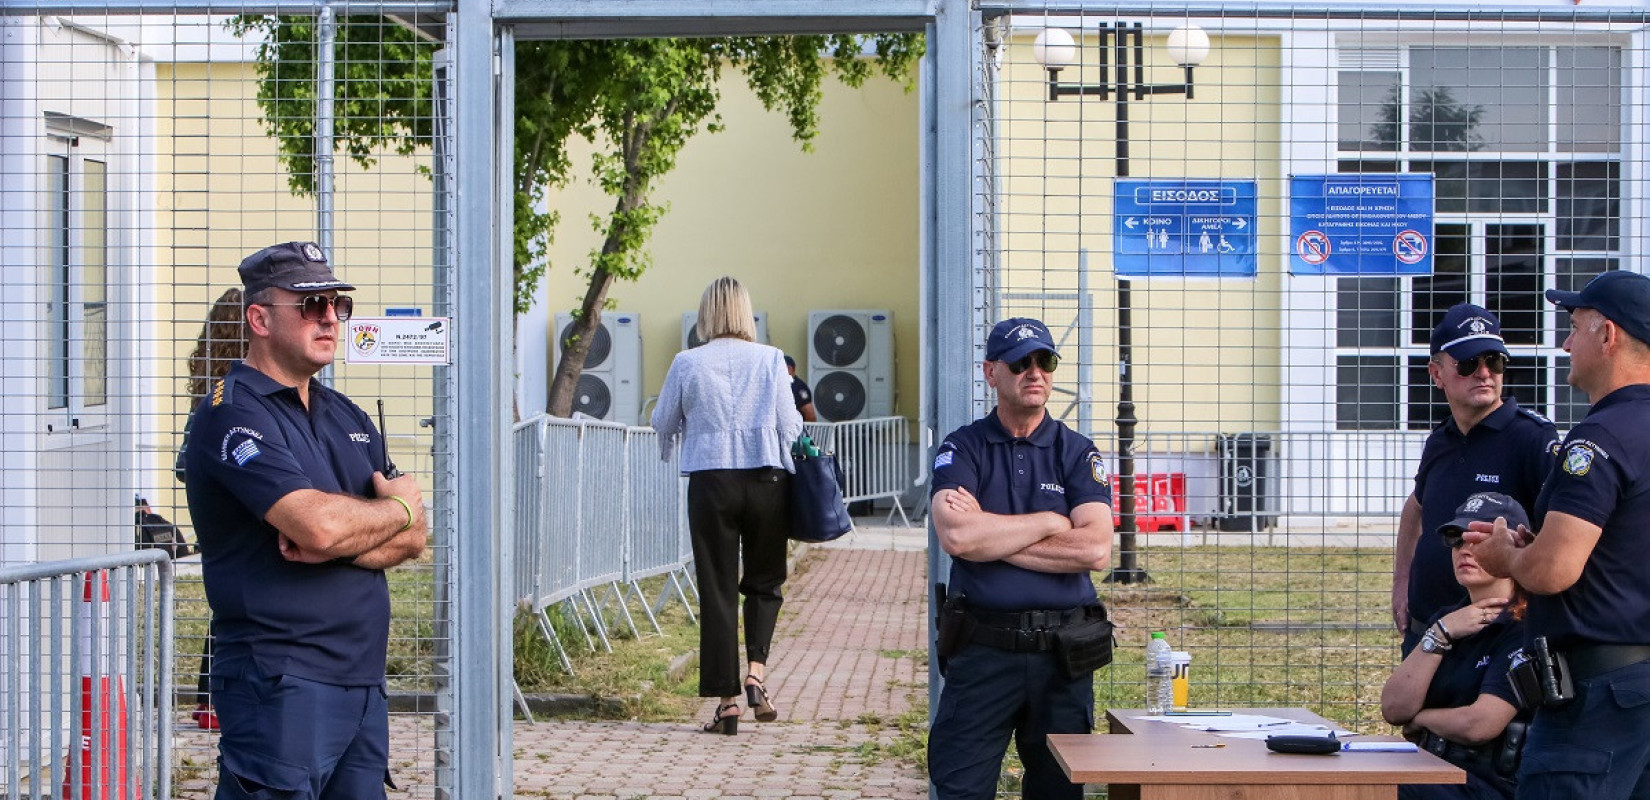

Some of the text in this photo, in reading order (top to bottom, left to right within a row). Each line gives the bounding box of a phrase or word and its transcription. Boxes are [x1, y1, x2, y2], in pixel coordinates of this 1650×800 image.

[1328, 186, 1398, 195] ΑΠΑΓΟΡΕΥΕΤΑΙ
[1152, 190, 1219, 201] ΕΙΣΟΔΟΣ
[353, 325, 379, 333] TOWN
